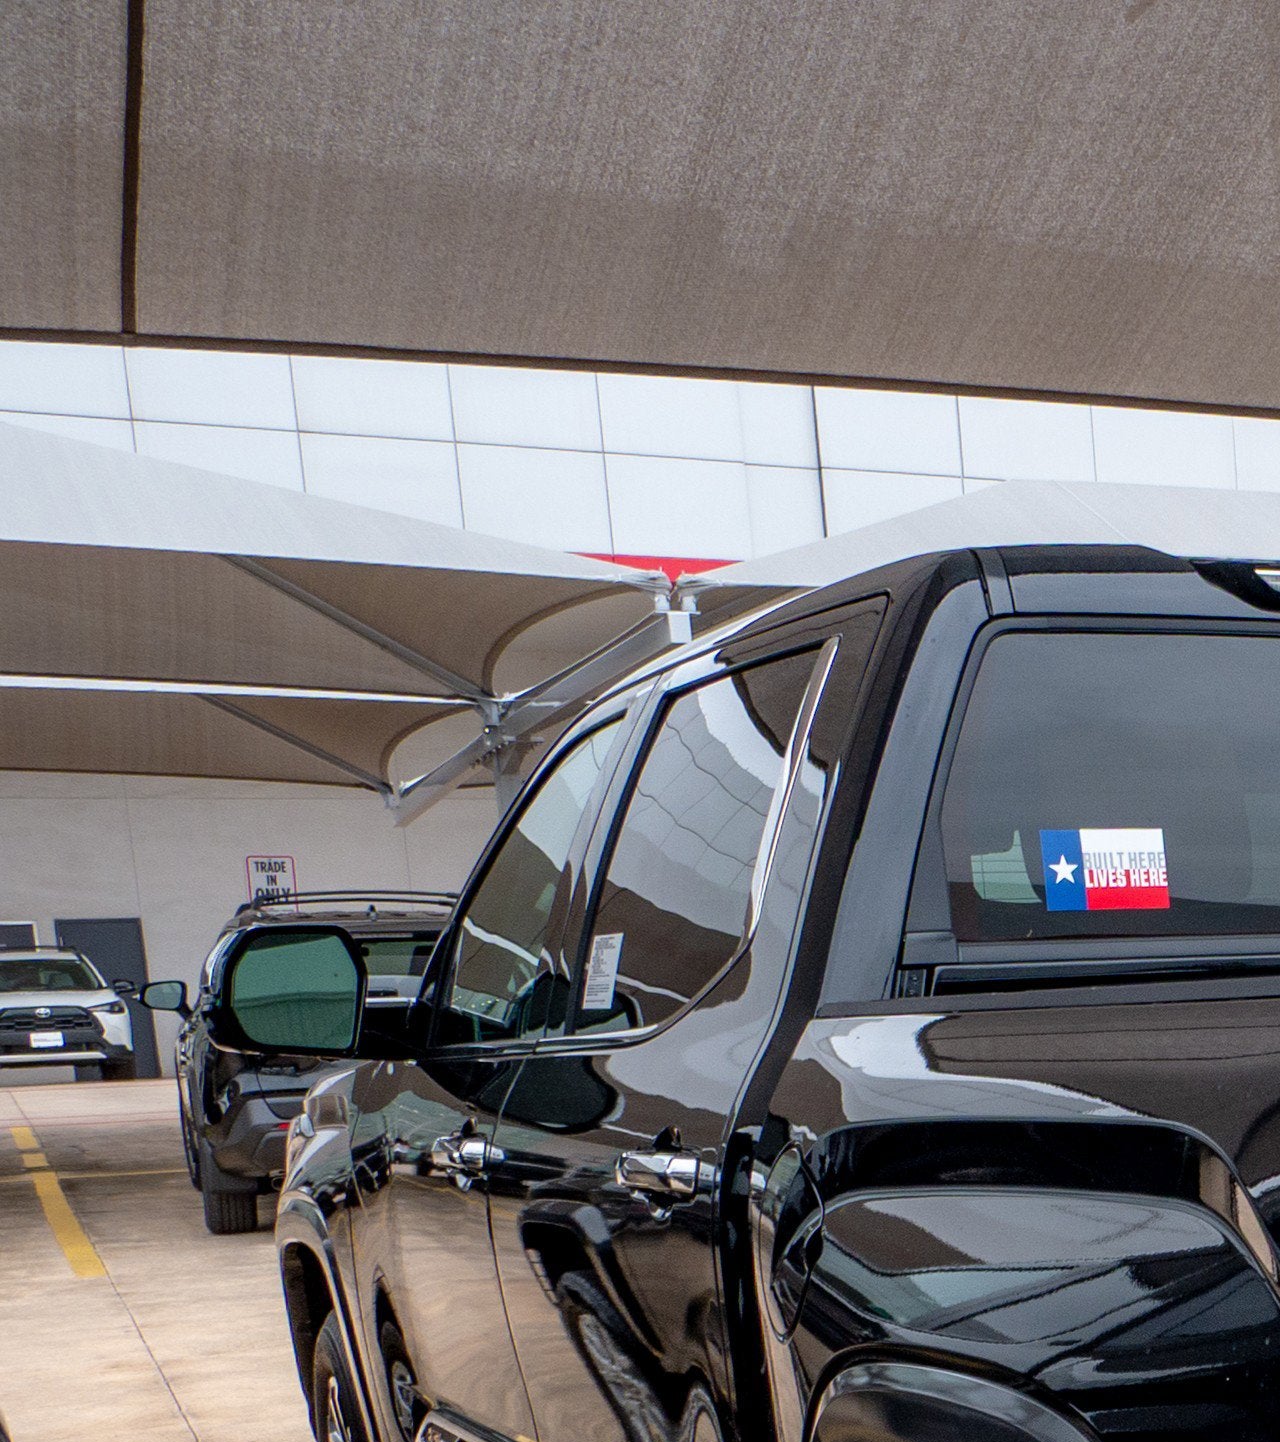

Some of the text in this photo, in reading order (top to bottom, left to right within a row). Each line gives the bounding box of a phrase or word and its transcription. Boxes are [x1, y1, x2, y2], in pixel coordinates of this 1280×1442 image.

[253, 861, 287, 873] TRADE
[1083, 851, 1166, 869] BUILT HERE
[266, 875, 278, 886] IN
[1085, 868, 1168, 888] LIVES HERE
